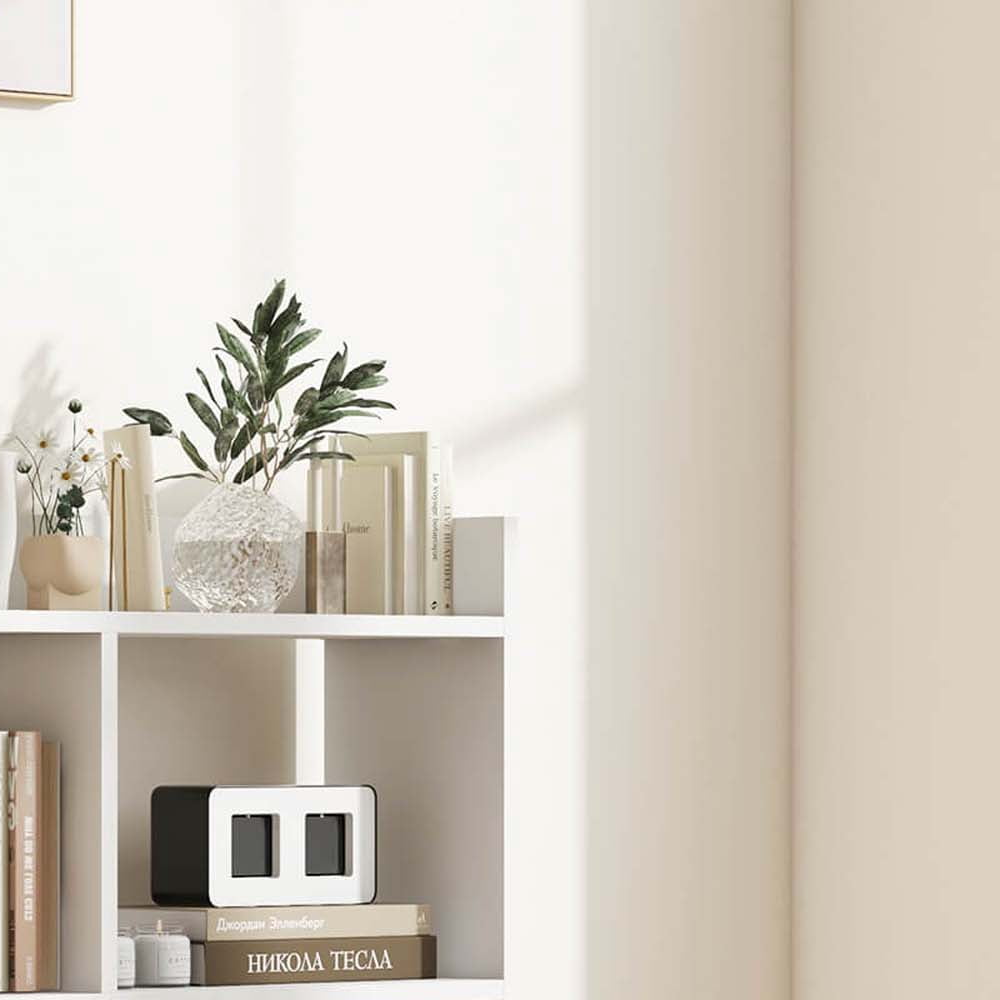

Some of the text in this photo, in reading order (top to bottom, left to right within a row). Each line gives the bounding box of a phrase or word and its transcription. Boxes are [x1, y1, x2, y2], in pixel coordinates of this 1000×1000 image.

[216, 915, 325, 933] Джордан Элленберг
[247, 949, 393, 974] НИКОЛА ТЕСЛА
